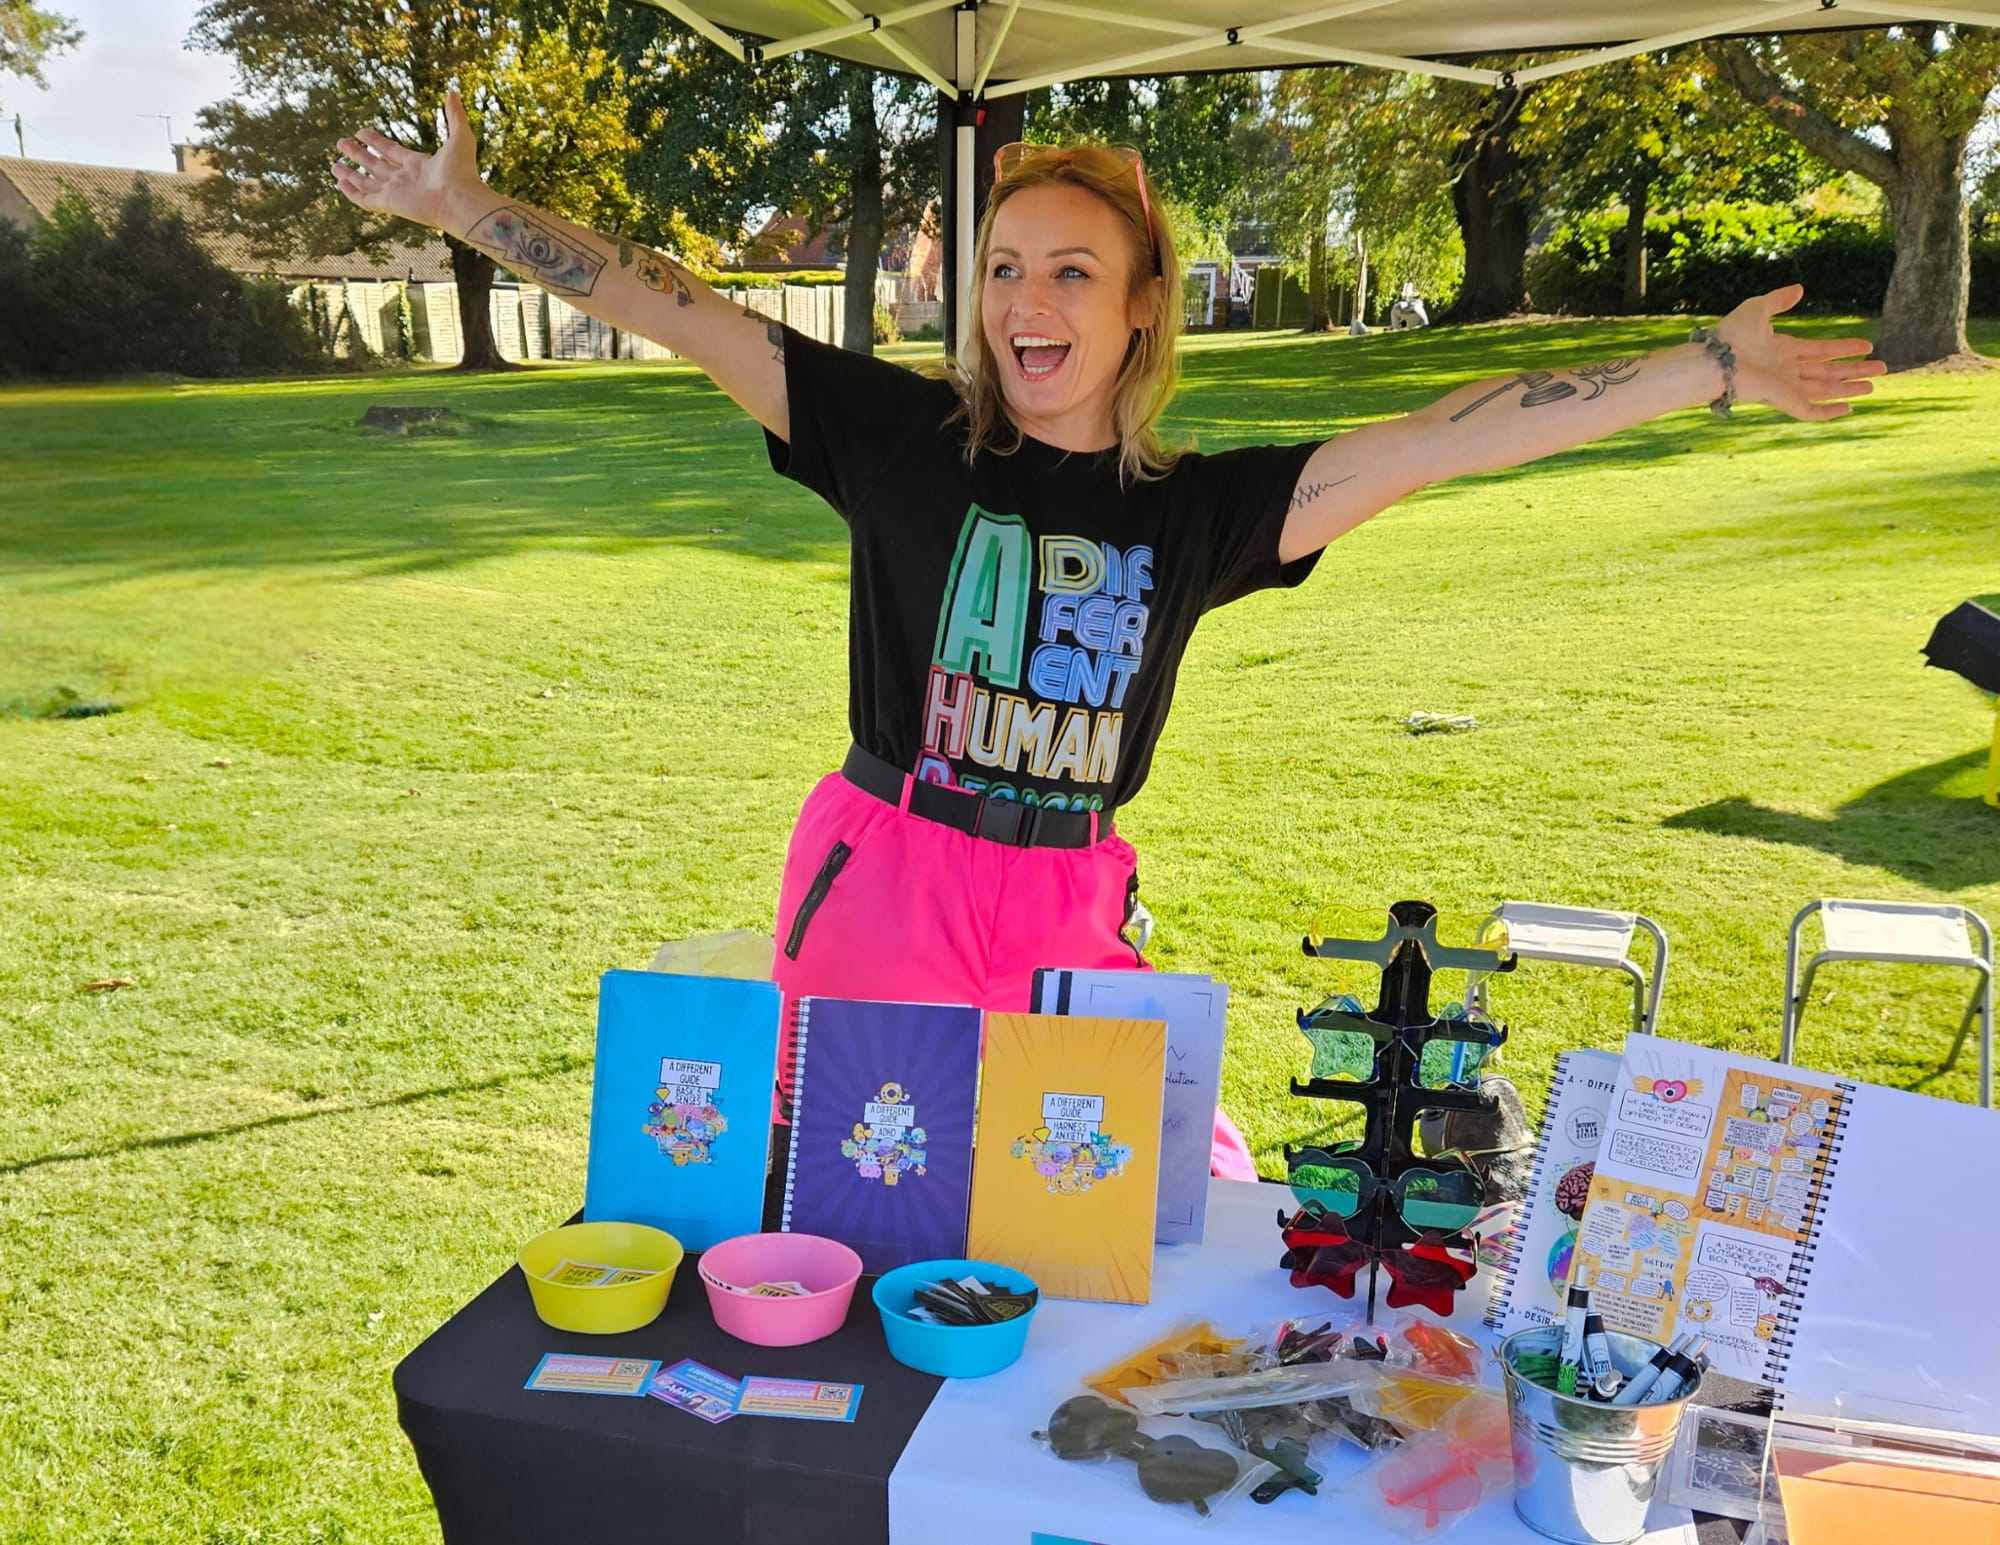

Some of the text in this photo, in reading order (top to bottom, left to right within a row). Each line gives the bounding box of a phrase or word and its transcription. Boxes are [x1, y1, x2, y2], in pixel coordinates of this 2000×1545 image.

[1038, 535, 1154, 601] DIF
[932, 502, 1032, 690] A
[1037, 592, 1150, 657] FER
[1027, 642, 1142, 709] ENT
[920, 663, 1124, 784] HUMAN
[669, 1061, 713, 1075] A DIFFERENT
[680, 1074, 700, 1085] GUIDE
[1568, 1075, 1616, 1094] A DIFFE
[870, 1105, 911, 1116] A DIFFERENT
[1050, 1097, 1096, 1109] A DIFFERENT
[880, 1114, 897, 1124] GUIDE
[1060, 1108, 1081, 1118] GUIDE
[879, 1127, 896, 1137] ADHD
[1053, 1121, 1087, 1133] HARNESS
[1055, 1131, 1085, 1141] ANXIETY
[1706, 1246, 1784, 1270] OUTSIDE OF THE
[1725, 1243, 1754, 1256] SPACE
[1758, 1251, 1778, 1261] FOR
[1708, 1254, 1777, 1276] BOX THINKERS
